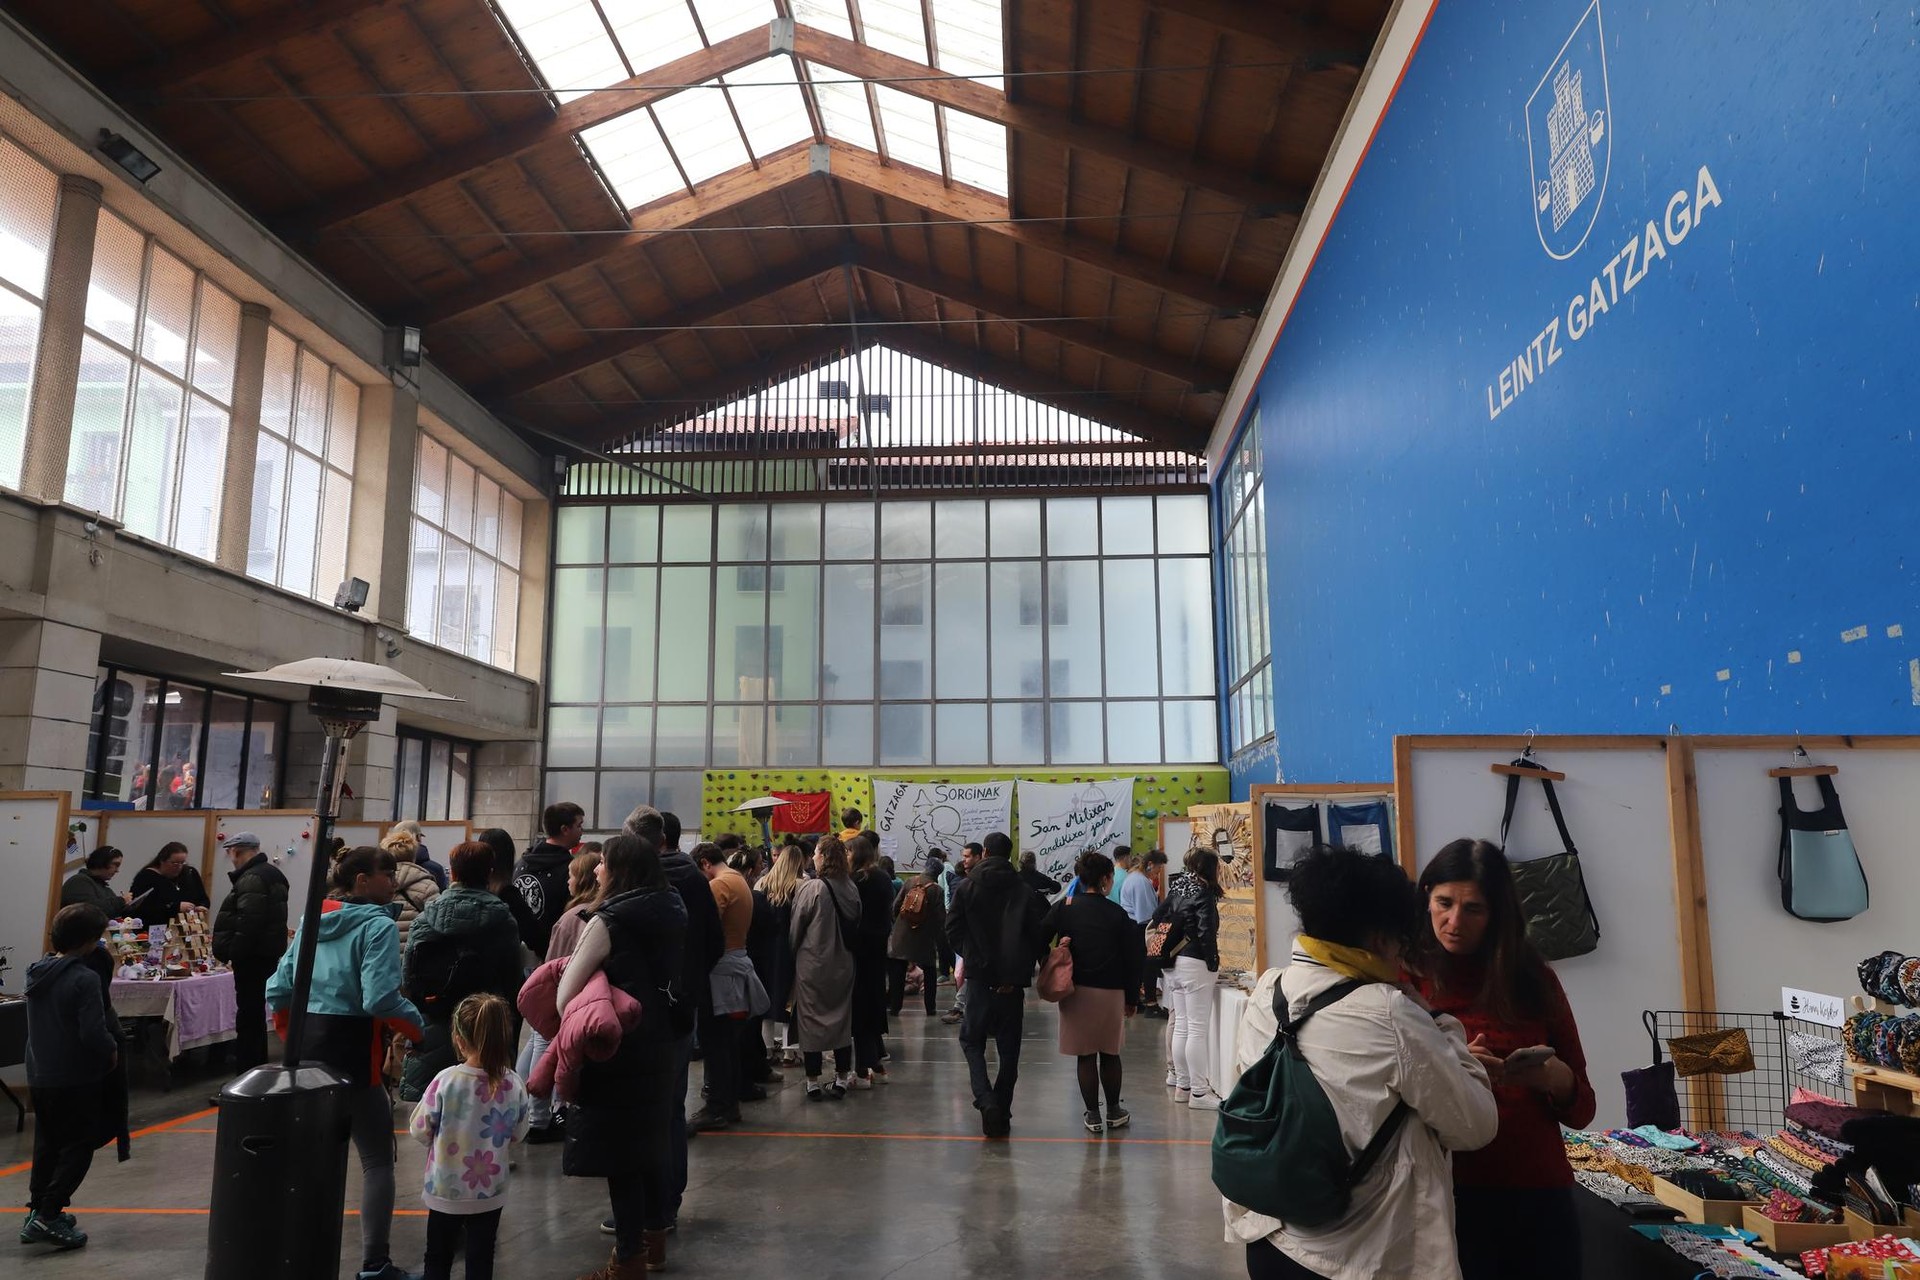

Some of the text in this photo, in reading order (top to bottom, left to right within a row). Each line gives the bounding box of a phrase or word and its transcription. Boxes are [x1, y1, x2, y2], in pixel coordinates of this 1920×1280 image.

[1487, 165, 1723, 421] LEINTZ GATZAGA
[880, 784, 909, 832] GATZAGA
[1030, 819, 1060, 838] San
[1090, 815, 1114, 837] jan
[1046, 859, 1068, 875] eta
